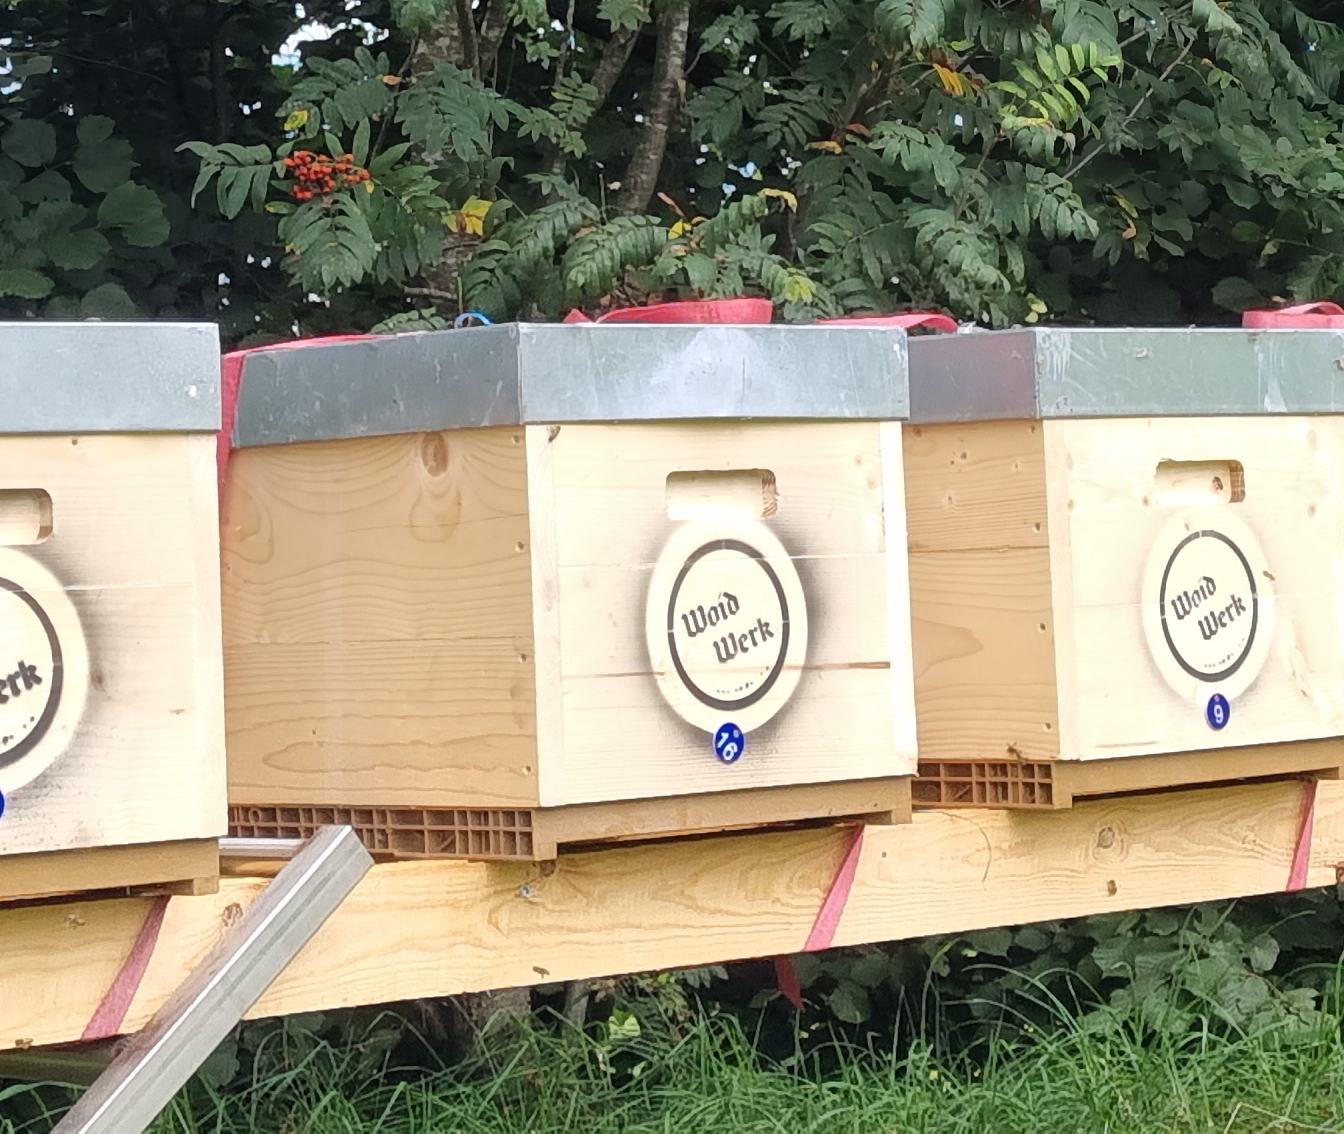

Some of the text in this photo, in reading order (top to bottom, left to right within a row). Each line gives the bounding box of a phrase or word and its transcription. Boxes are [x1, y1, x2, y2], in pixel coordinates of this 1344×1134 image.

[681, 591, 740, 638] Woid
[1171, 575, 1217, 620] Woid
[1198, 594, 1246, 640] Werk
[713, 618, 775, 664] Werk
[1213, 704, 1224, 724] 9
[717, 732, 738, 761] 16
